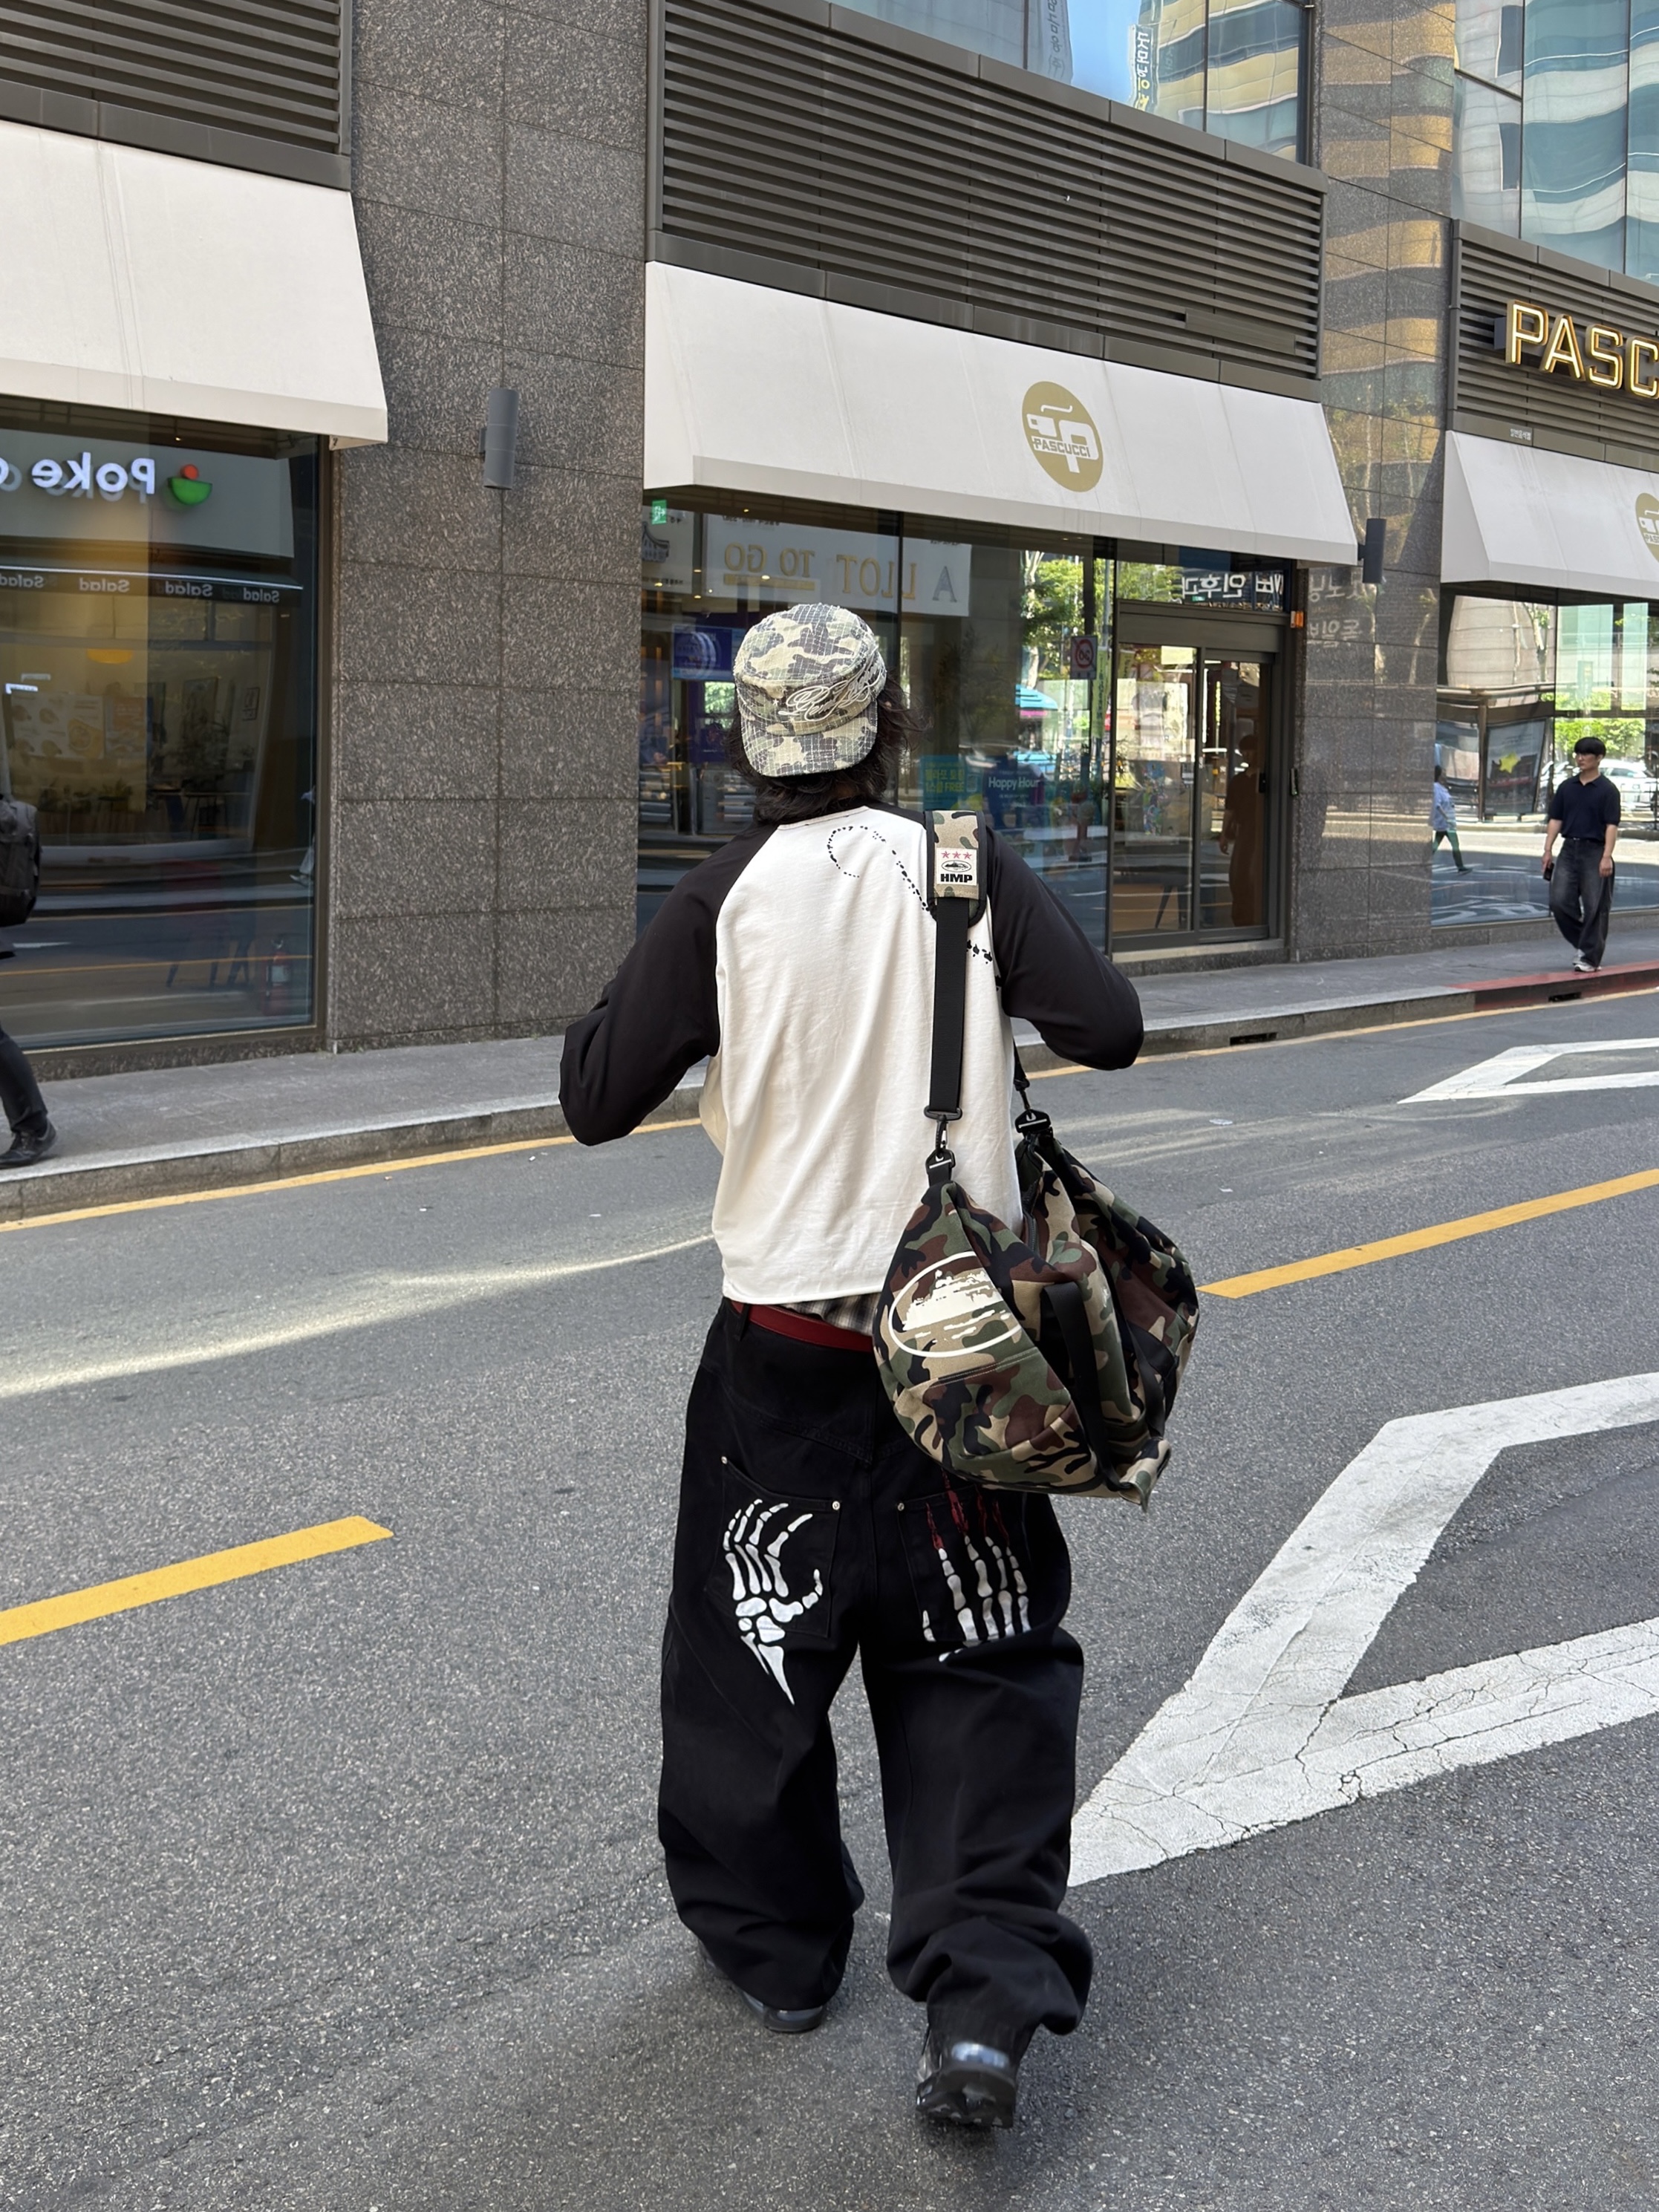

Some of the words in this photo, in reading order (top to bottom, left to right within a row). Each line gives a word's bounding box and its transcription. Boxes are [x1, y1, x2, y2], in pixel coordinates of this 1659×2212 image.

[1033, 438, 1091, 458] PASCUCCI
[988, 777, 1017, 791] Happy
[1018, 777, 1039, 788] Hour
[940, 873, 973, 883] HMP
